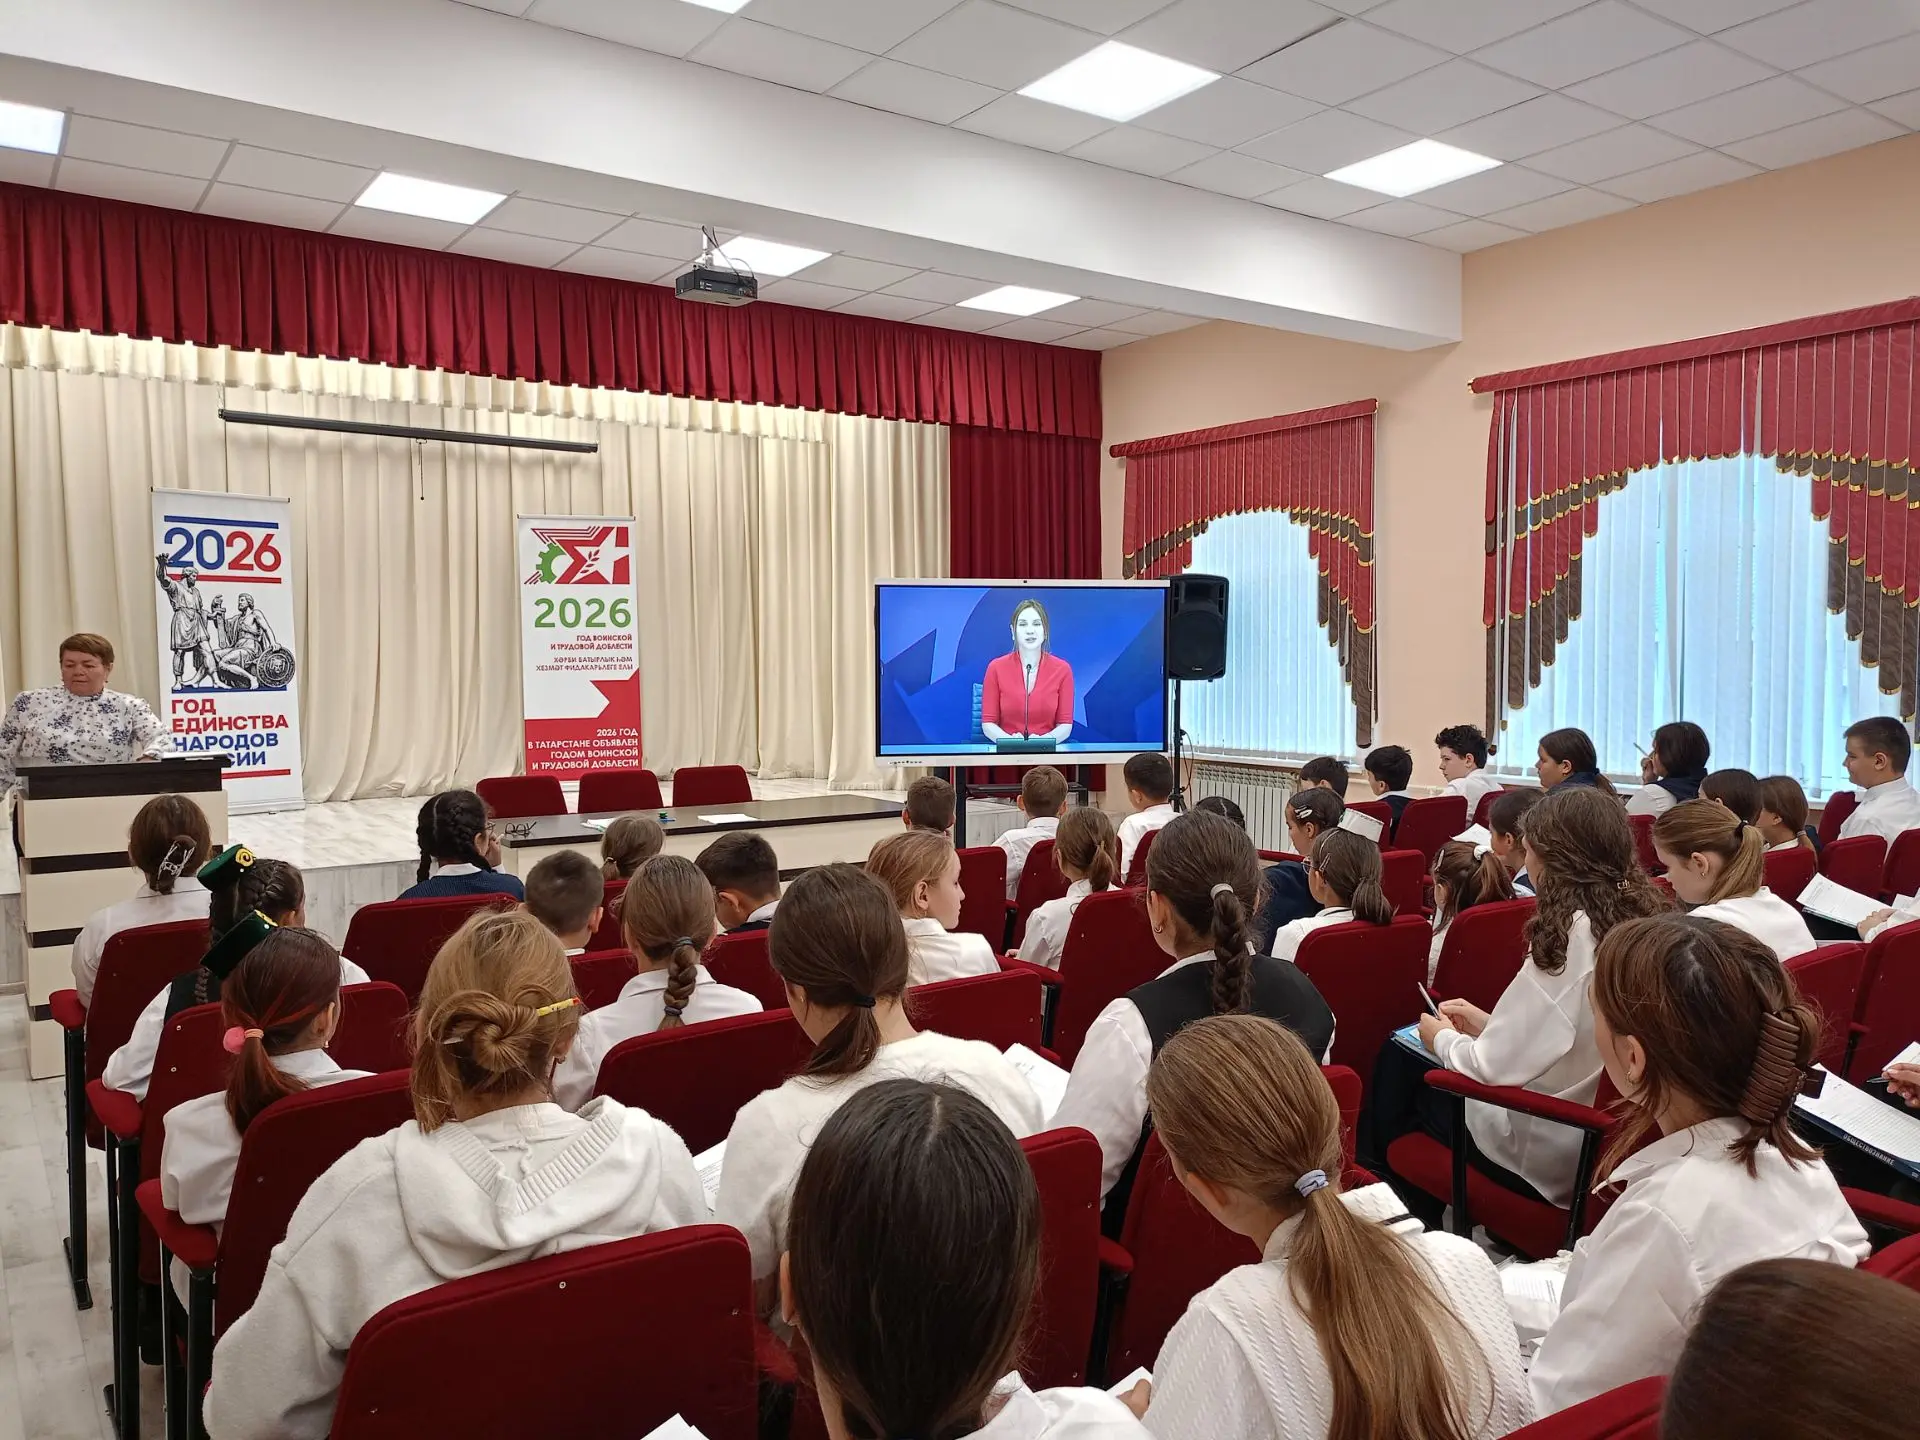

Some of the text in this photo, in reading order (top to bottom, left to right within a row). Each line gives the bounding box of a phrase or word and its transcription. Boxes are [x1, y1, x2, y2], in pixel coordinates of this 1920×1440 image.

[164, 527, 282, 572] 2026
[534, 597, 631, 628] 2026
[593, 633, 632, 641] ВОИНСКОЙ
[172, 698, 217, 716] ГОД
[172, 714, 289, 735] ЕДИНСТВА
[596, 728, 639, 737] 2026 ГОД
[173, 732, 279, 752] НАРОДОВ
[527, 738, 639, 749] В ТАТАРСТАНЕ ОБЪЯВЛЕН
[550, 747, 639, 760] ГОДОМ ВОИНСКОЙ
[532, 758, 639, 770] И ТРУДОВОЙ ДОБЛЕСТИ
